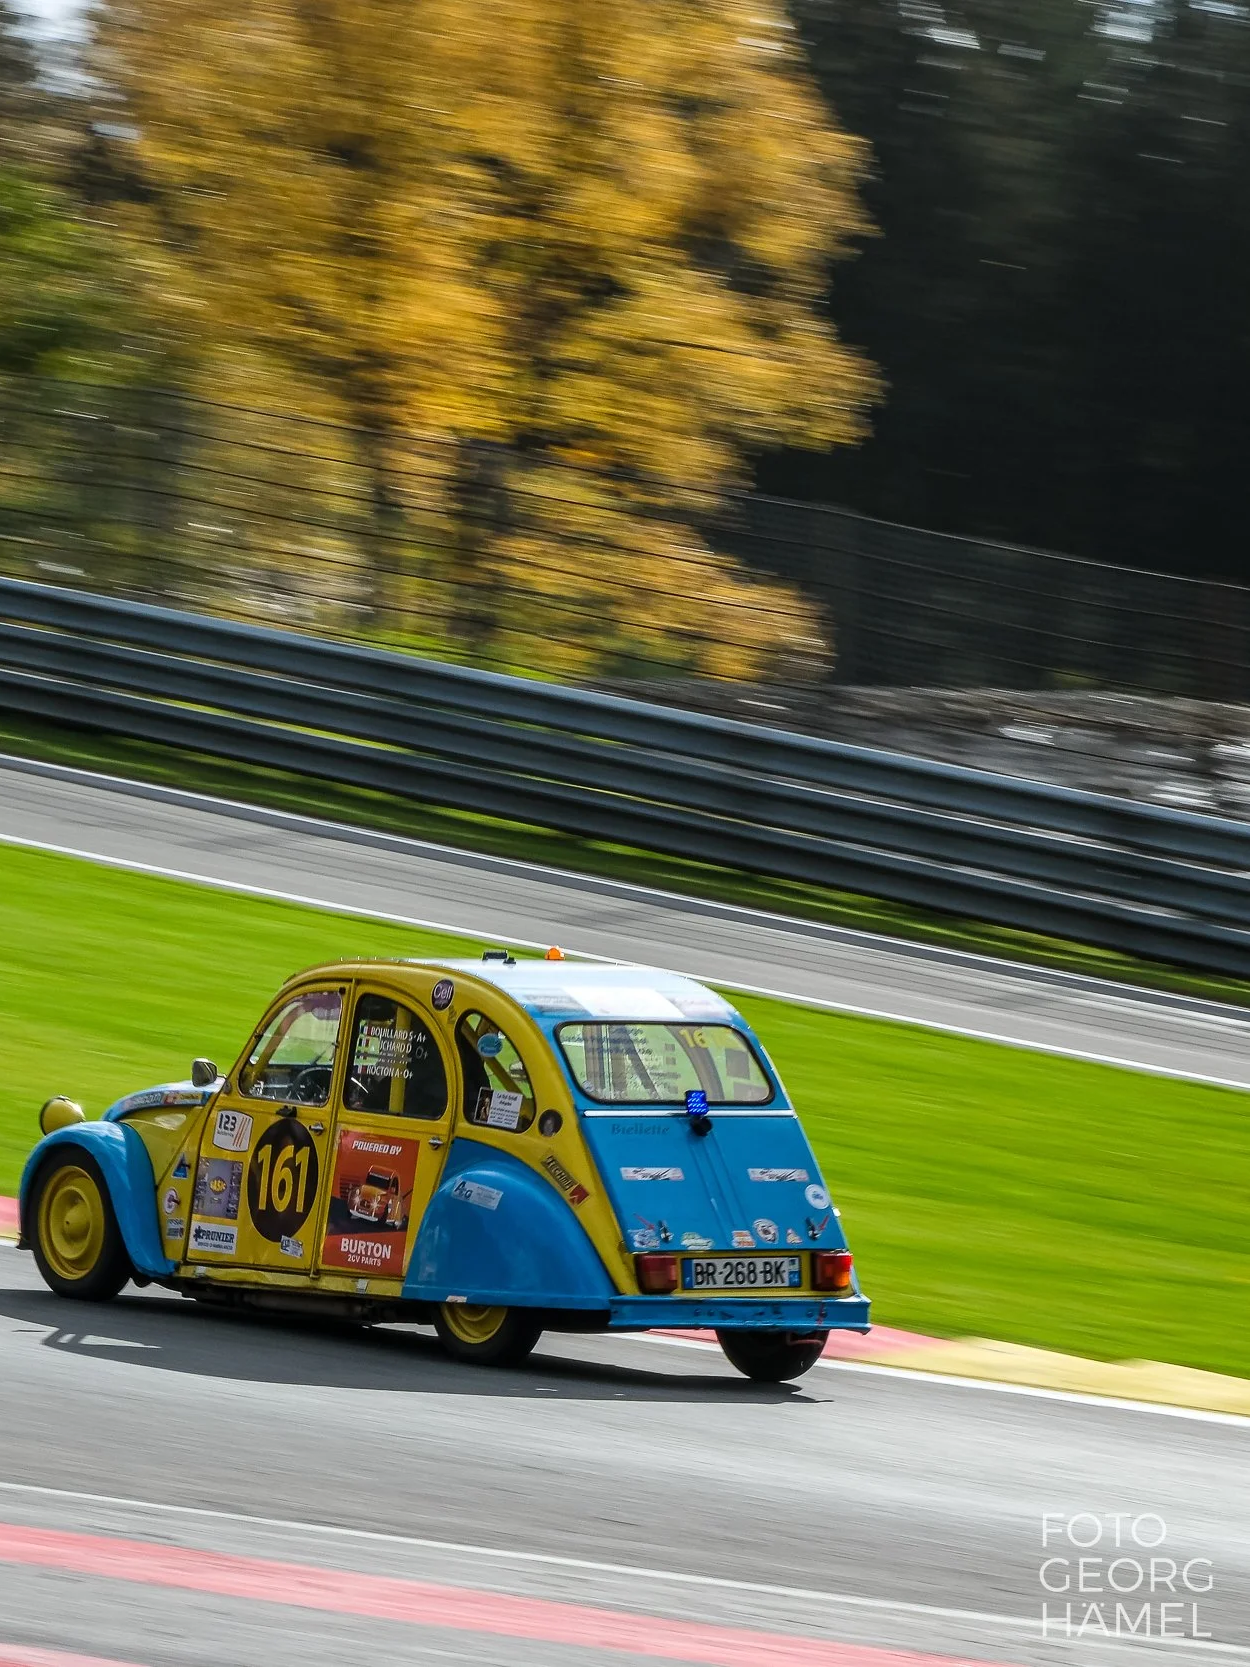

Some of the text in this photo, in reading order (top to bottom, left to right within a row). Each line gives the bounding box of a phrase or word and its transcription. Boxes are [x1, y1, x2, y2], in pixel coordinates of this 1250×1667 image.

[218, 1113, 237, 1132] 123
[352, 1140, 402, 1156] POWERED BY
[257, 1144, 310, 1213] 161
[201, 1229, 235, 1244] PRUNIER
[340, 1237, 392, 1259] BURTON
[347, 1254, 382, 1267] 2CV PARTS
